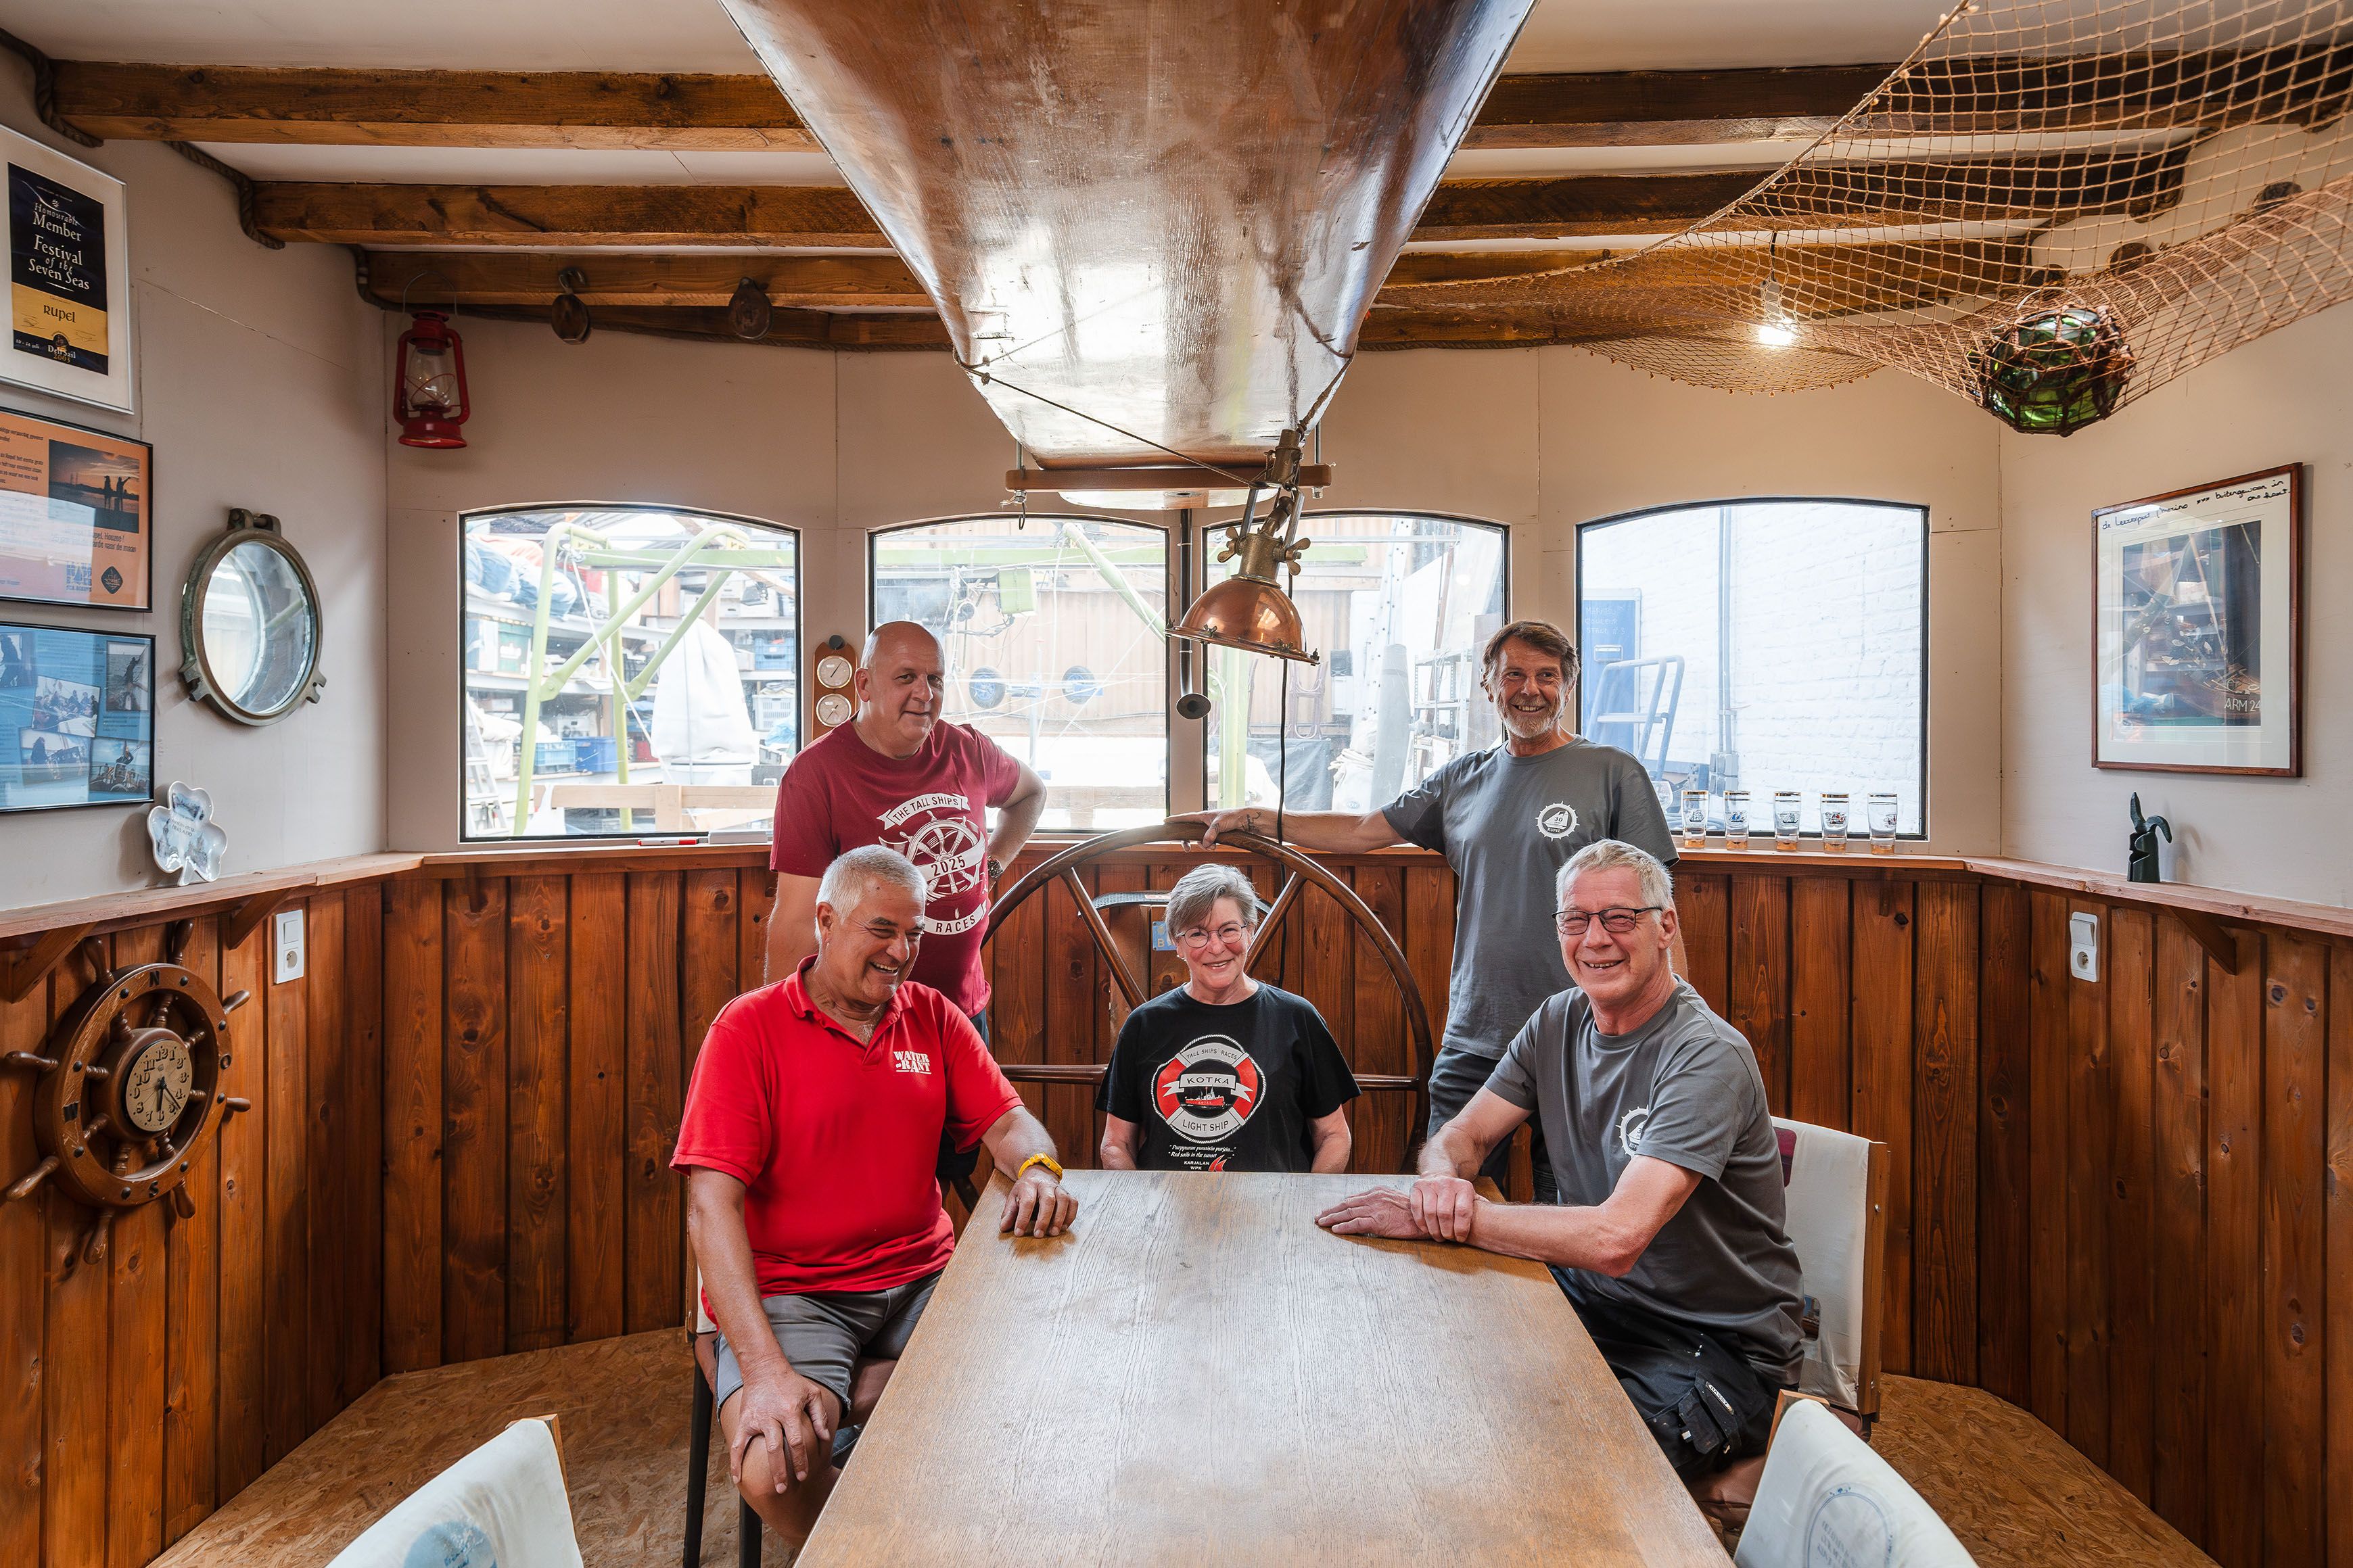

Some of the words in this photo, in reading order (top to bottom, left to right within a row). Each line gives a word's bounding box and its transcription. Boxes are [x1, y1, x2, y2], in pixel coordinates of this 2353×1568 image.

[32, 211, 81, 241] Member
[33, 234, 83, 266] Festival
[45, 257, 55, 268] of
[28, 258, 62, 281] Seven
[65, 270, 90, 289] Seas
[2102, 521, 2111, 529] de
[2224, 698, 2247, 712] ARM
[893, 807, 910, 822] THE
[910, 797, 931, 811] TALL
[931, 796, 958, 806] SHIPS
[931, 855, 966, 877] 2025
[935, 915, 975, 933] RACES
[149, 971, 160, 987] N
[156, 1048, 168, 1062] 12
[169, 1049, 175, 1061] 1
[893, 1050, 930, 1063] WATER
[1221, 1050, 1237, 1060] RACES
[143, 1059, 155, 1072] 11
[177, 1058, 183, 1070] 2
[135, 1072, 150, 1087] 10
[179, 1072, 187, 1083] 3
[175, 1088, 183, 1100] 4
[136, 1101, 144, 1114] 8
[168, 1103, 176, 1114] 5
[145, 1110, 153, 1122] 7
[157, 1110, 165, 1122] 6
[1182, 1119, 1207, 1131] LIGHT
[1209, 1120, 1229, 1131] SHIP
[148, 1181, 158, 1197] S
